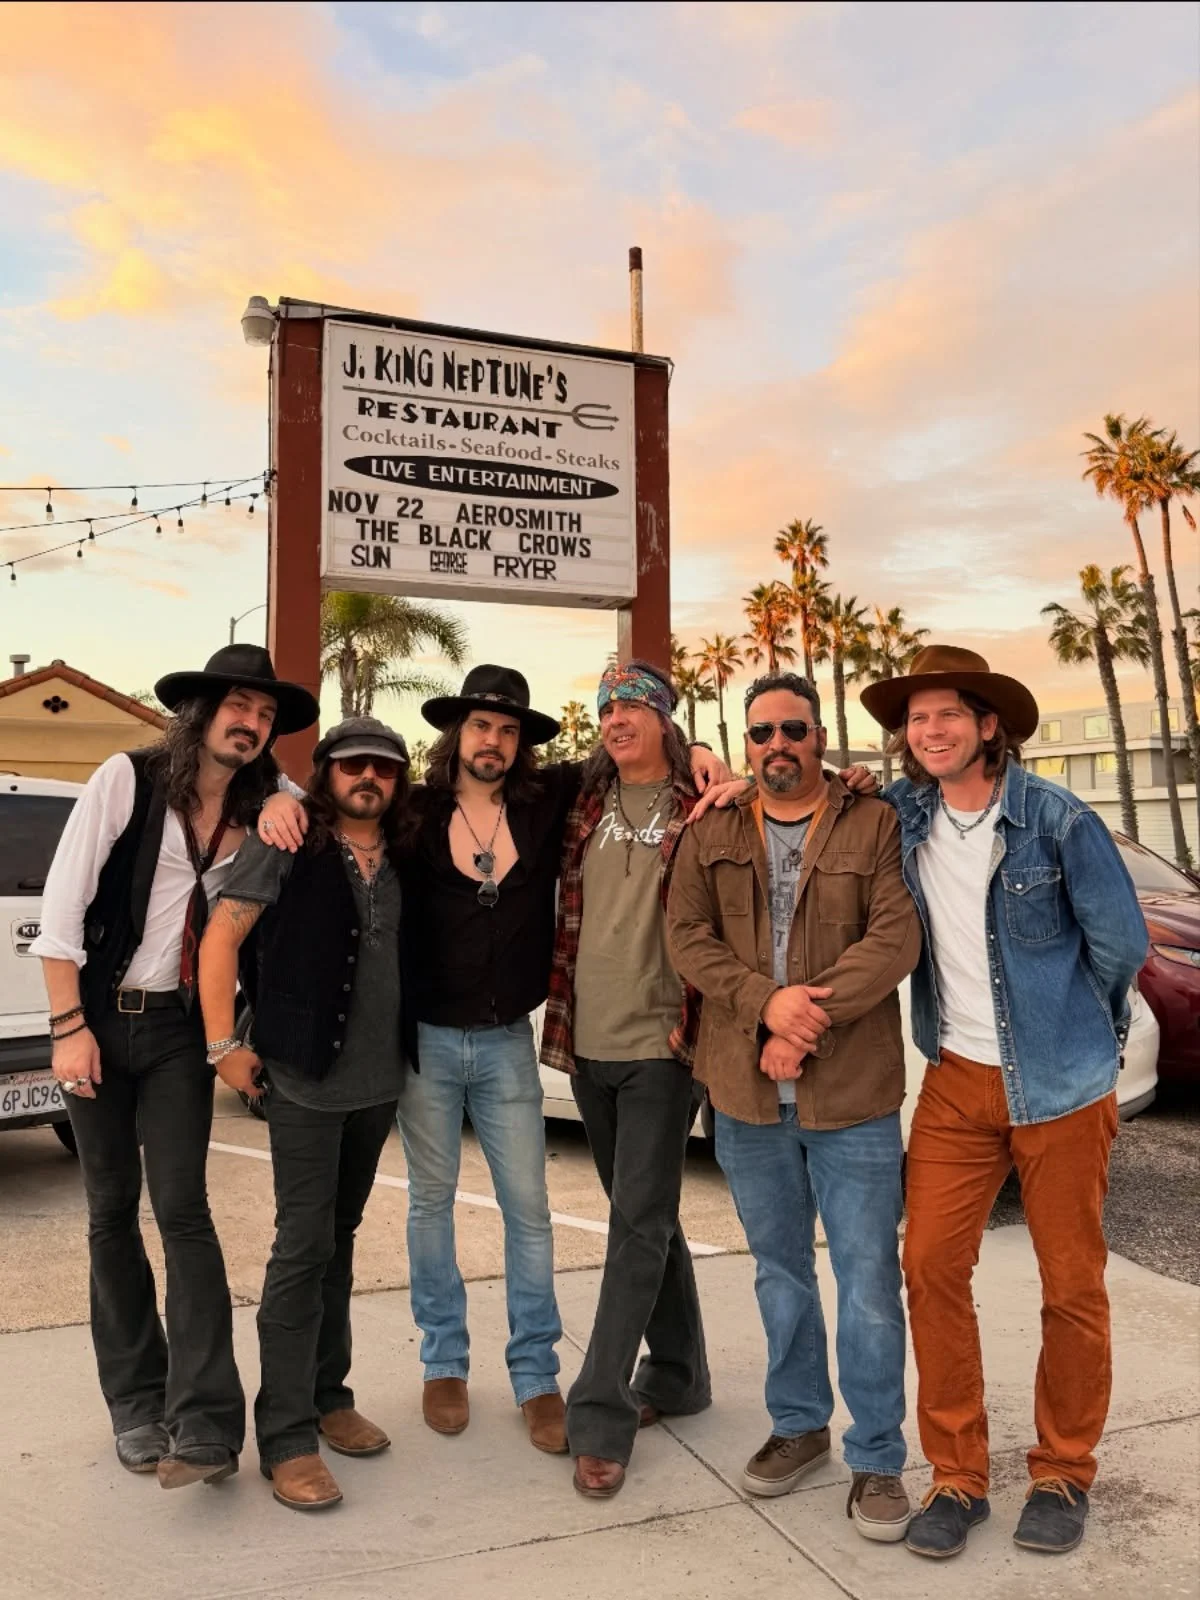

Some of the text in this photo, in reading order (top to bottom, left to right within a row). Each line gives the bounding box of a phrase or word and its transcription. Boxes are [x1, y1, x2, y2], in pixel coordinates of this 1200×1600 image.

[343, 344, 568, 404] J. KING NEPTUNE'S
[358, 397, 563, 439] RESTAURANT
[371, 459, 597, 497] LIVE ENTERTAINMENT
[328, 489, 582, 533] NOV 22 AEROSMITH
[356, 518, 592, 558] THE BLACK CROWS
[351, 544, 557, 581] SUN GEORGE FRYER
[594, 811, 666, 850] Fende
[2, 1084, 61, 1112] 6PJC96
